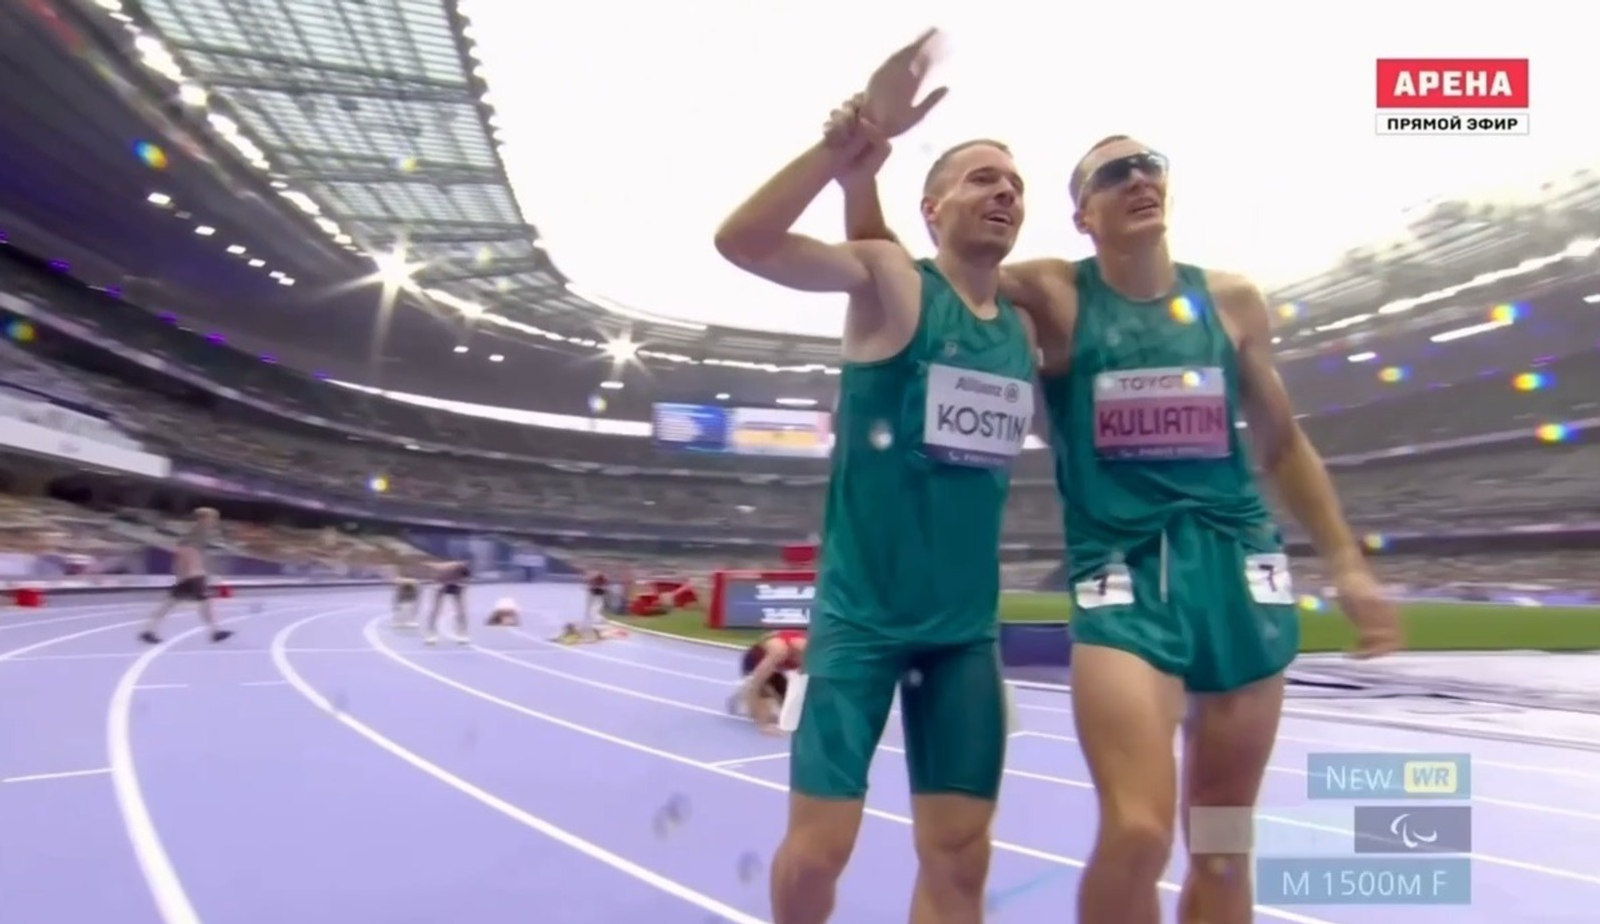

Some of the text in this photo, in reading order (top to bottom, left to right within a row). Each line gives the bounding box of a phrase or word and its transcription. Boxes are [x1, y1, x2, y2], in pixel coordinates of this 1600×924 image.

[937, 403, 1027, 442] KOSTIN
[1098, 405, 1224, 437] KULIATIN
[1258, 563, 1278, 593] 7
